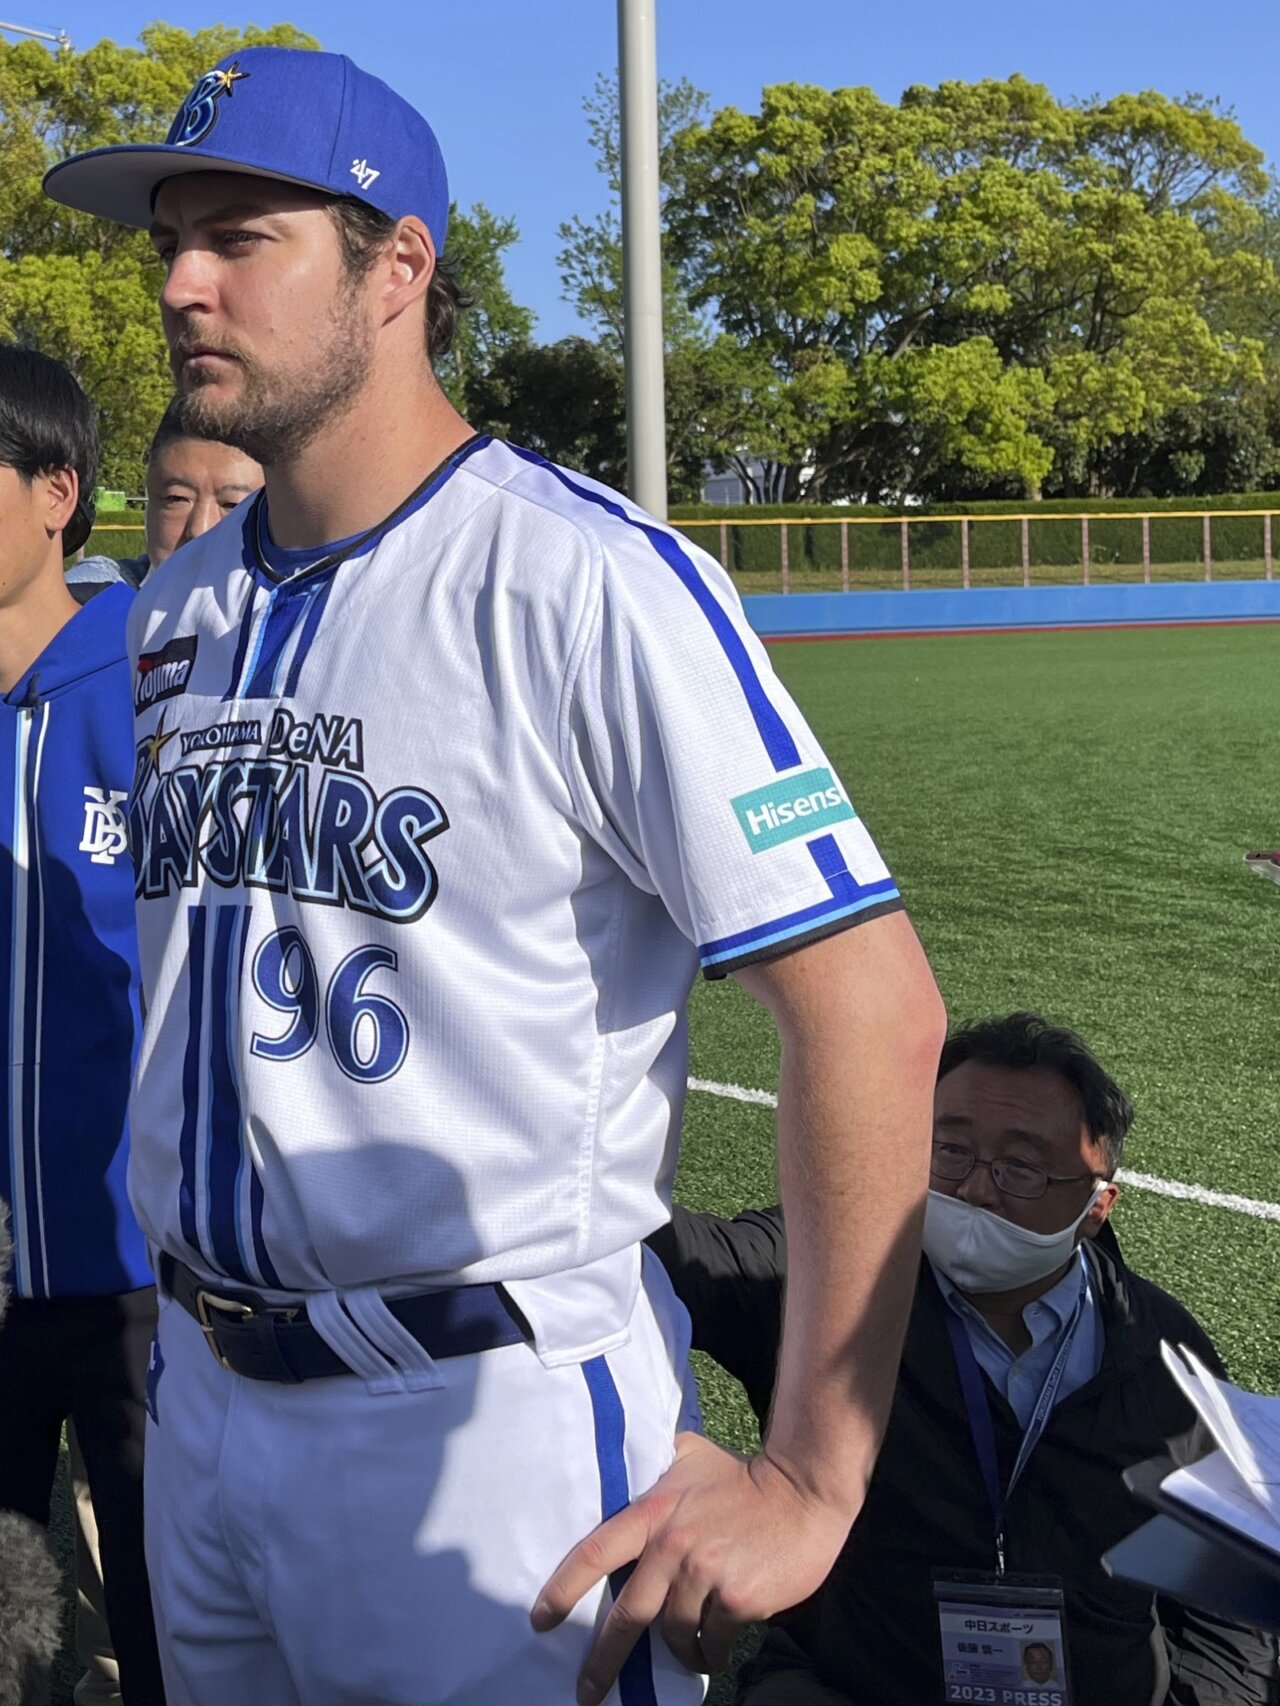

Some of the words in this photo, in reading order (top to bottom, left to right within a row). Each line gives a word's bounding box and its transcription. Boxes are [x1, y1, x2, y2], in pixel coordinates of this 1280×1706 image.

[181, 720, 262, 755] YOKOHAMA
[267, 708, 365, 773] DeNA
[746, 786, 848, 836] Hisens
[249, 925, 410, 1084] 96
[964, 1619, 1035, 1635] 中日スポーツ
[950, 1684, 996, 1702] 2023
[1002, 1688, 1063, 1706] PRESS
